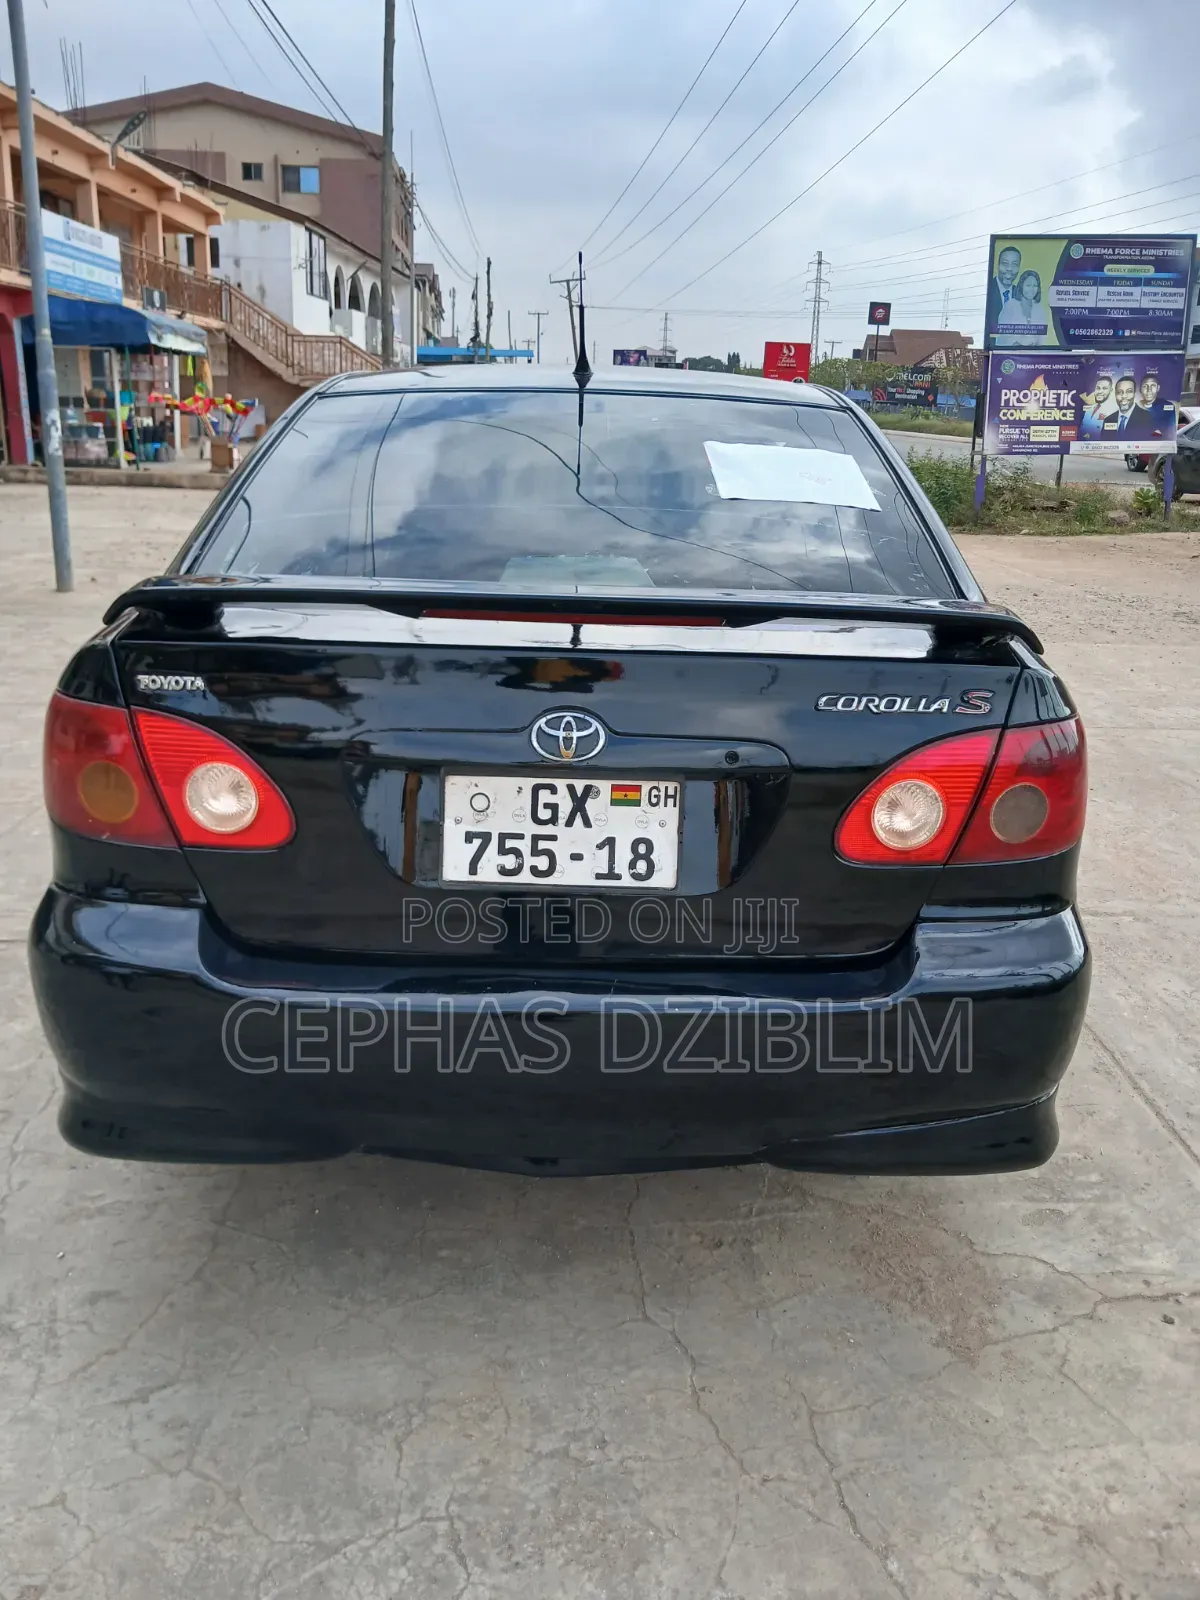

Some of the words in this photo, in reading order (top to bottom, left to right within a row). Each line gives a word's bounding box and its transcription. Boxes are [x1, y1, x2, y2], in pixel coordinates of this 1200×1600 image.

[1085, 247, 1113, 255] RHEMA
[1106, 308, 1130, 316] 7:00PM
[1148, 309, 1173, 317] 8:30AM
[999, 408, 1075, 421] CONFERENCE
[136, 674, 205, 691] TOYOTA
[815, 693, 951, 714] COROLLA
[953, 689, 996, 714] S
[647, 785, 678, 808] GH
[531, 783, 594, 828] GX
